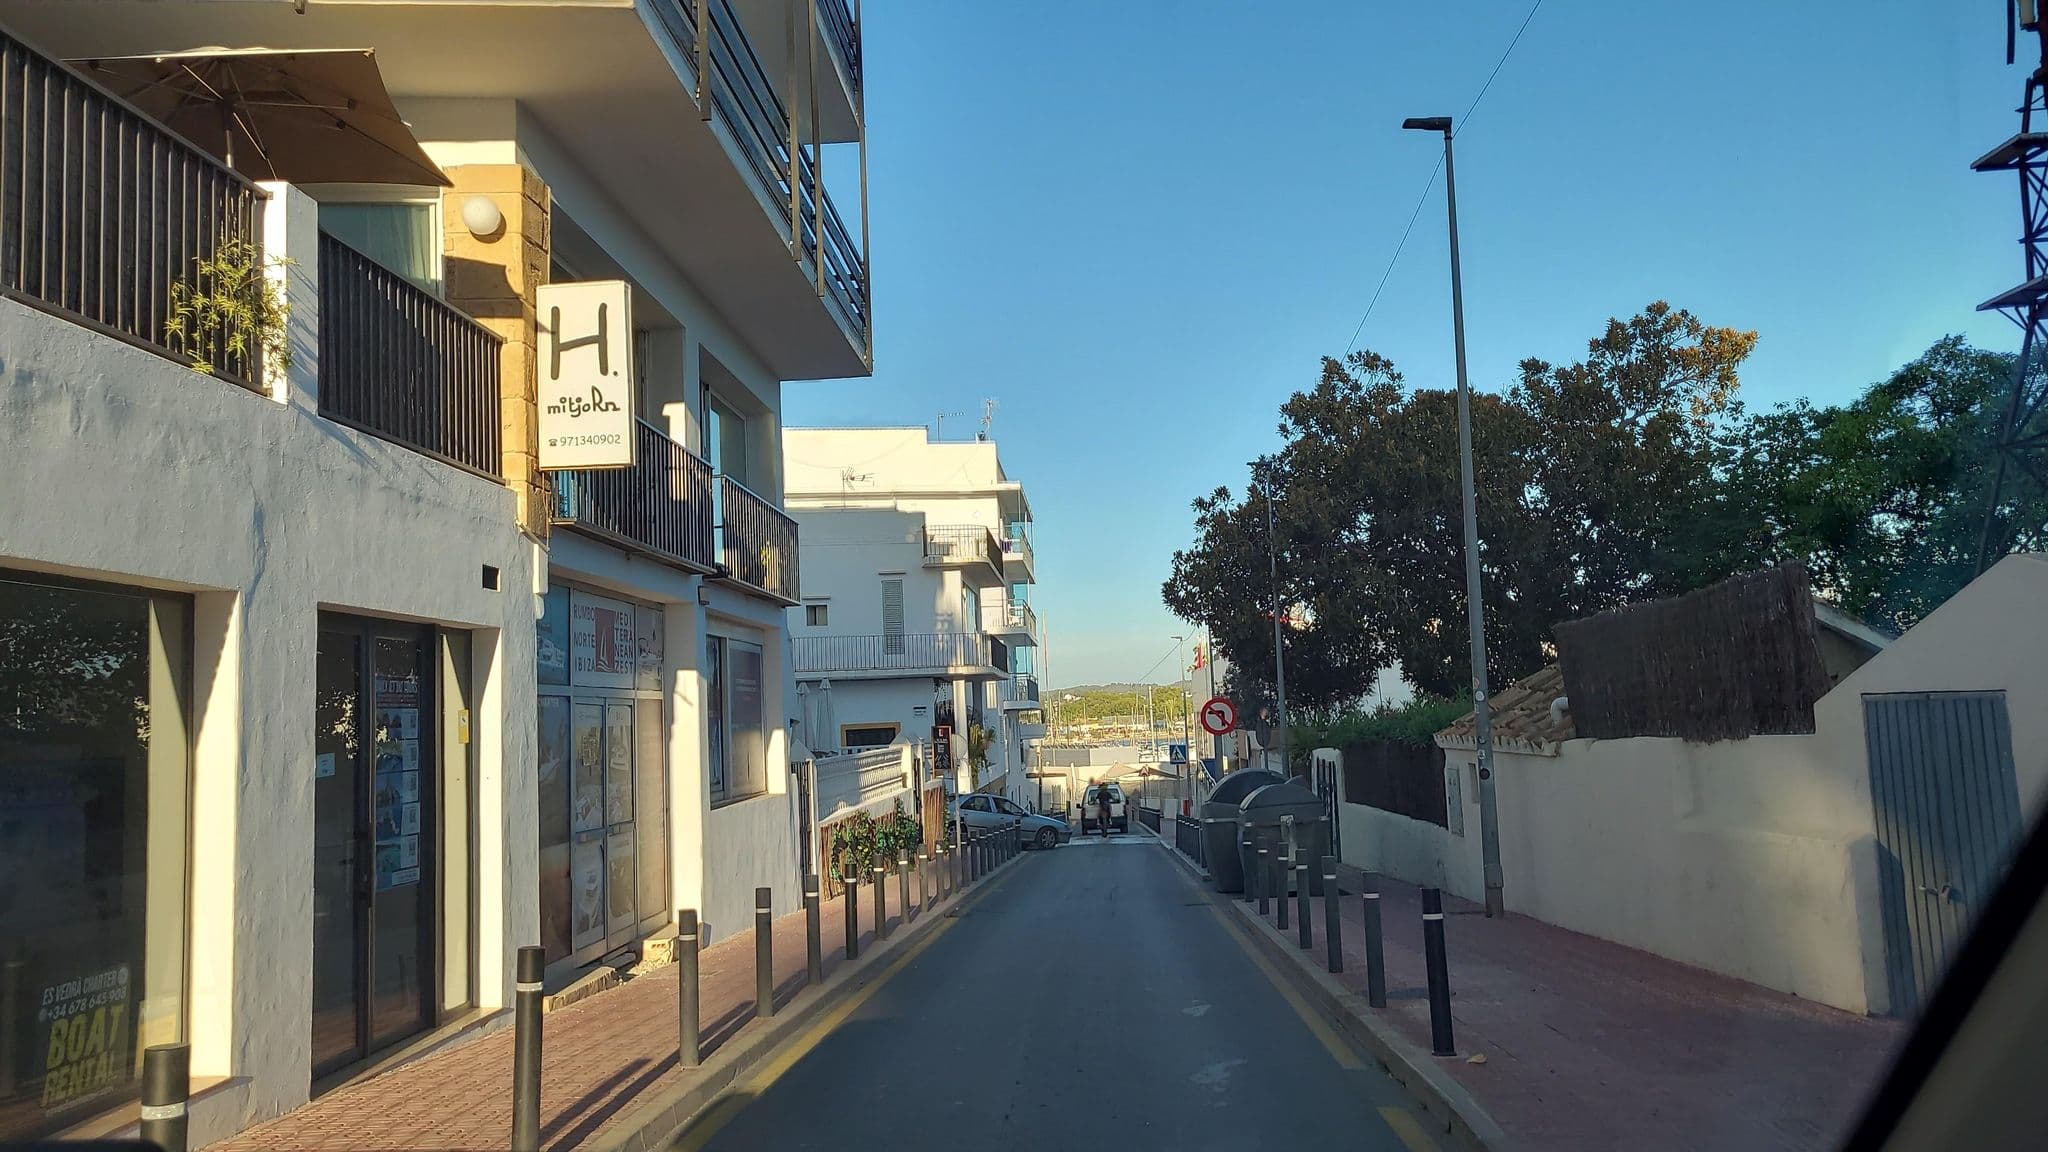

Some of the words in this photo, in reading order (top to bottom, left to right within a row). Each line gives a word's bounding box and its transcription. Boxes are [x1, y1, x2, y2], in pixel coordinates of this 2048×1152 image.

[559, 434, 621, 447] 971340902
[573, 604, 595, 621] RUMBO
[615, 611, 632, 628] MEDI
[574, 632, 595, 648] NORTE
[615, 644, 633, 658] NEAN
[575, 656, 595, 672] IBIZA
[615, 660, 633, 674] ZEST
[42, 986, 55, 1006] ES
[83, 969, 117, 995] CHARTER
[47, 1004, 67, 1020] +34
[68, 997, 87, 1015] 678
[89, 991, 108, 1009] 645
[47, 1005, 124, 1070] BOAT
[40, 1050, 118, 1108] RENTAL
